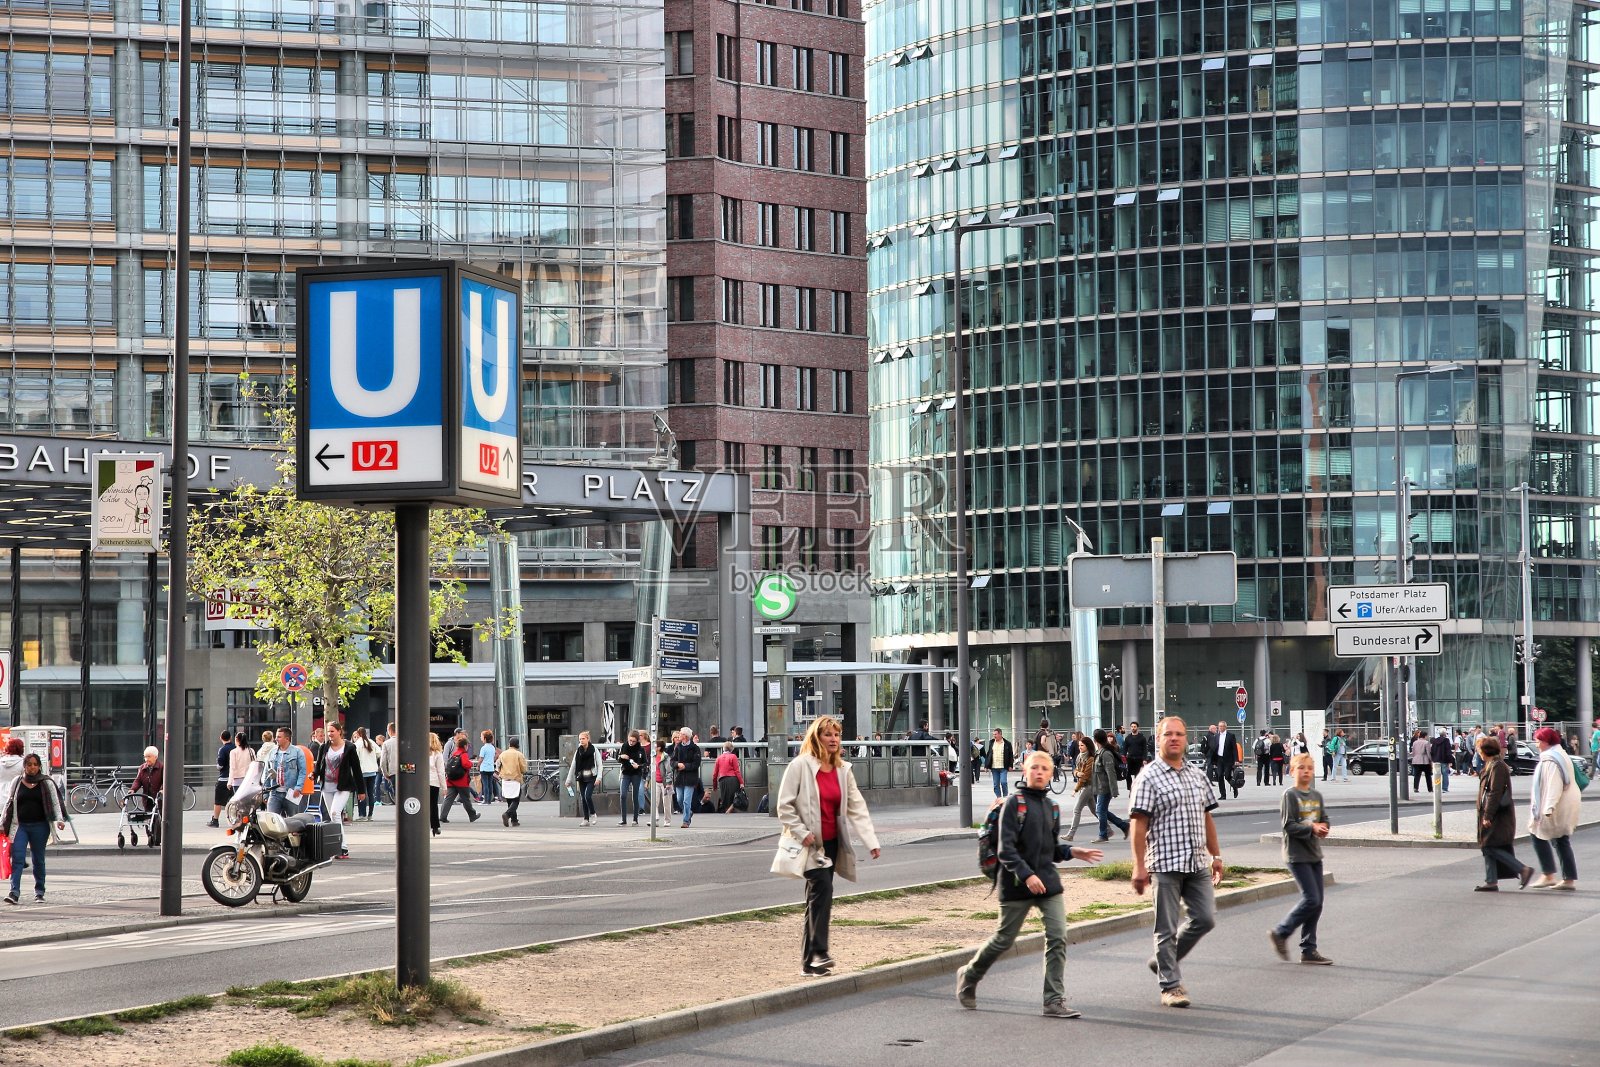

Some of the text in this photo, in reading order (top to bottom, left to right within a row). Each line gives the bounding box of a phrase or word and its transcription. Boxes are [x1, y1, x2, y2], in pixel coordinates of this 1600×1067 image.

[329, 287, 421, 418] U
[469, 290, 509, 423] U
[357, 443, 394, 468] U2
[481, 447, 498, 472] U2
[584, 473, 701, 503] PLATZ
[99, 515, 116, 523] 300
[760, 576, 790, 616] S
[1350, 589, 1427, 599] Potsdamer Platz
[1375, 605, 1438, 614] Ufer/Arkaden
[1353, 636, 1411, 646] Bundesrat
[662, 682, 698, 693] Potsdamer Platz
[1236, 693, 1247, 703] STOP
